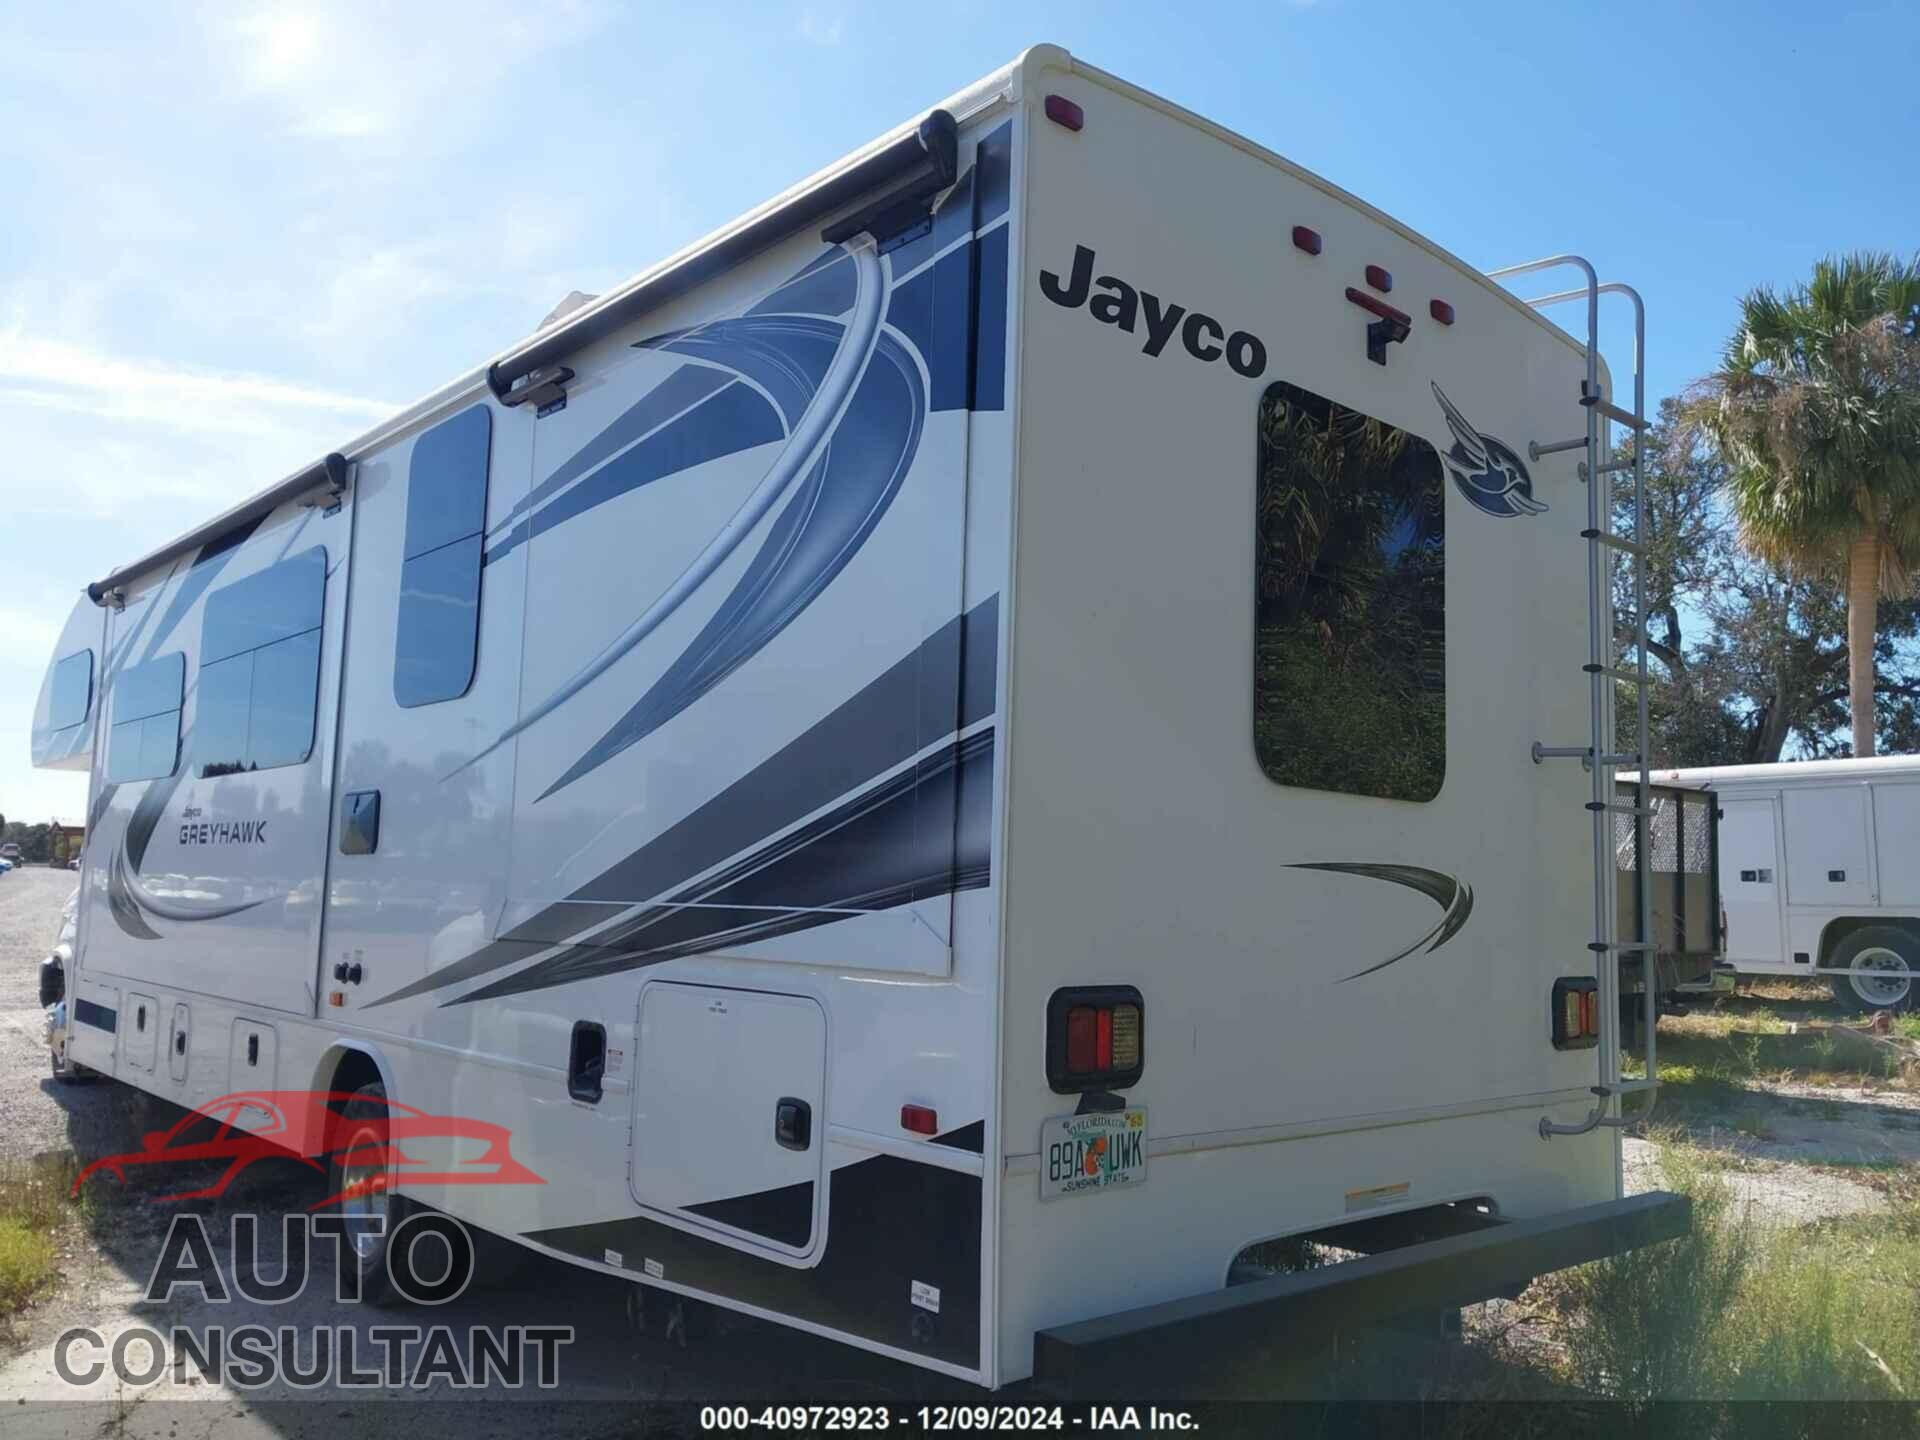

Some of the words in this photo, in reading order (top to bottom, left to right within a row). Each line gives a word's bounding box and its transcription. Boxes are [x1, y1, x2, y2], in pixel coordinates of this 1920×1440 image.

[1039, 244, 1267, 379] Jayco
[180, 821, 267, 845] GREYHAWK
[1050, 1140, 1085, 1181] 89A
[1109, 1130, 1142, 1170] UWK
